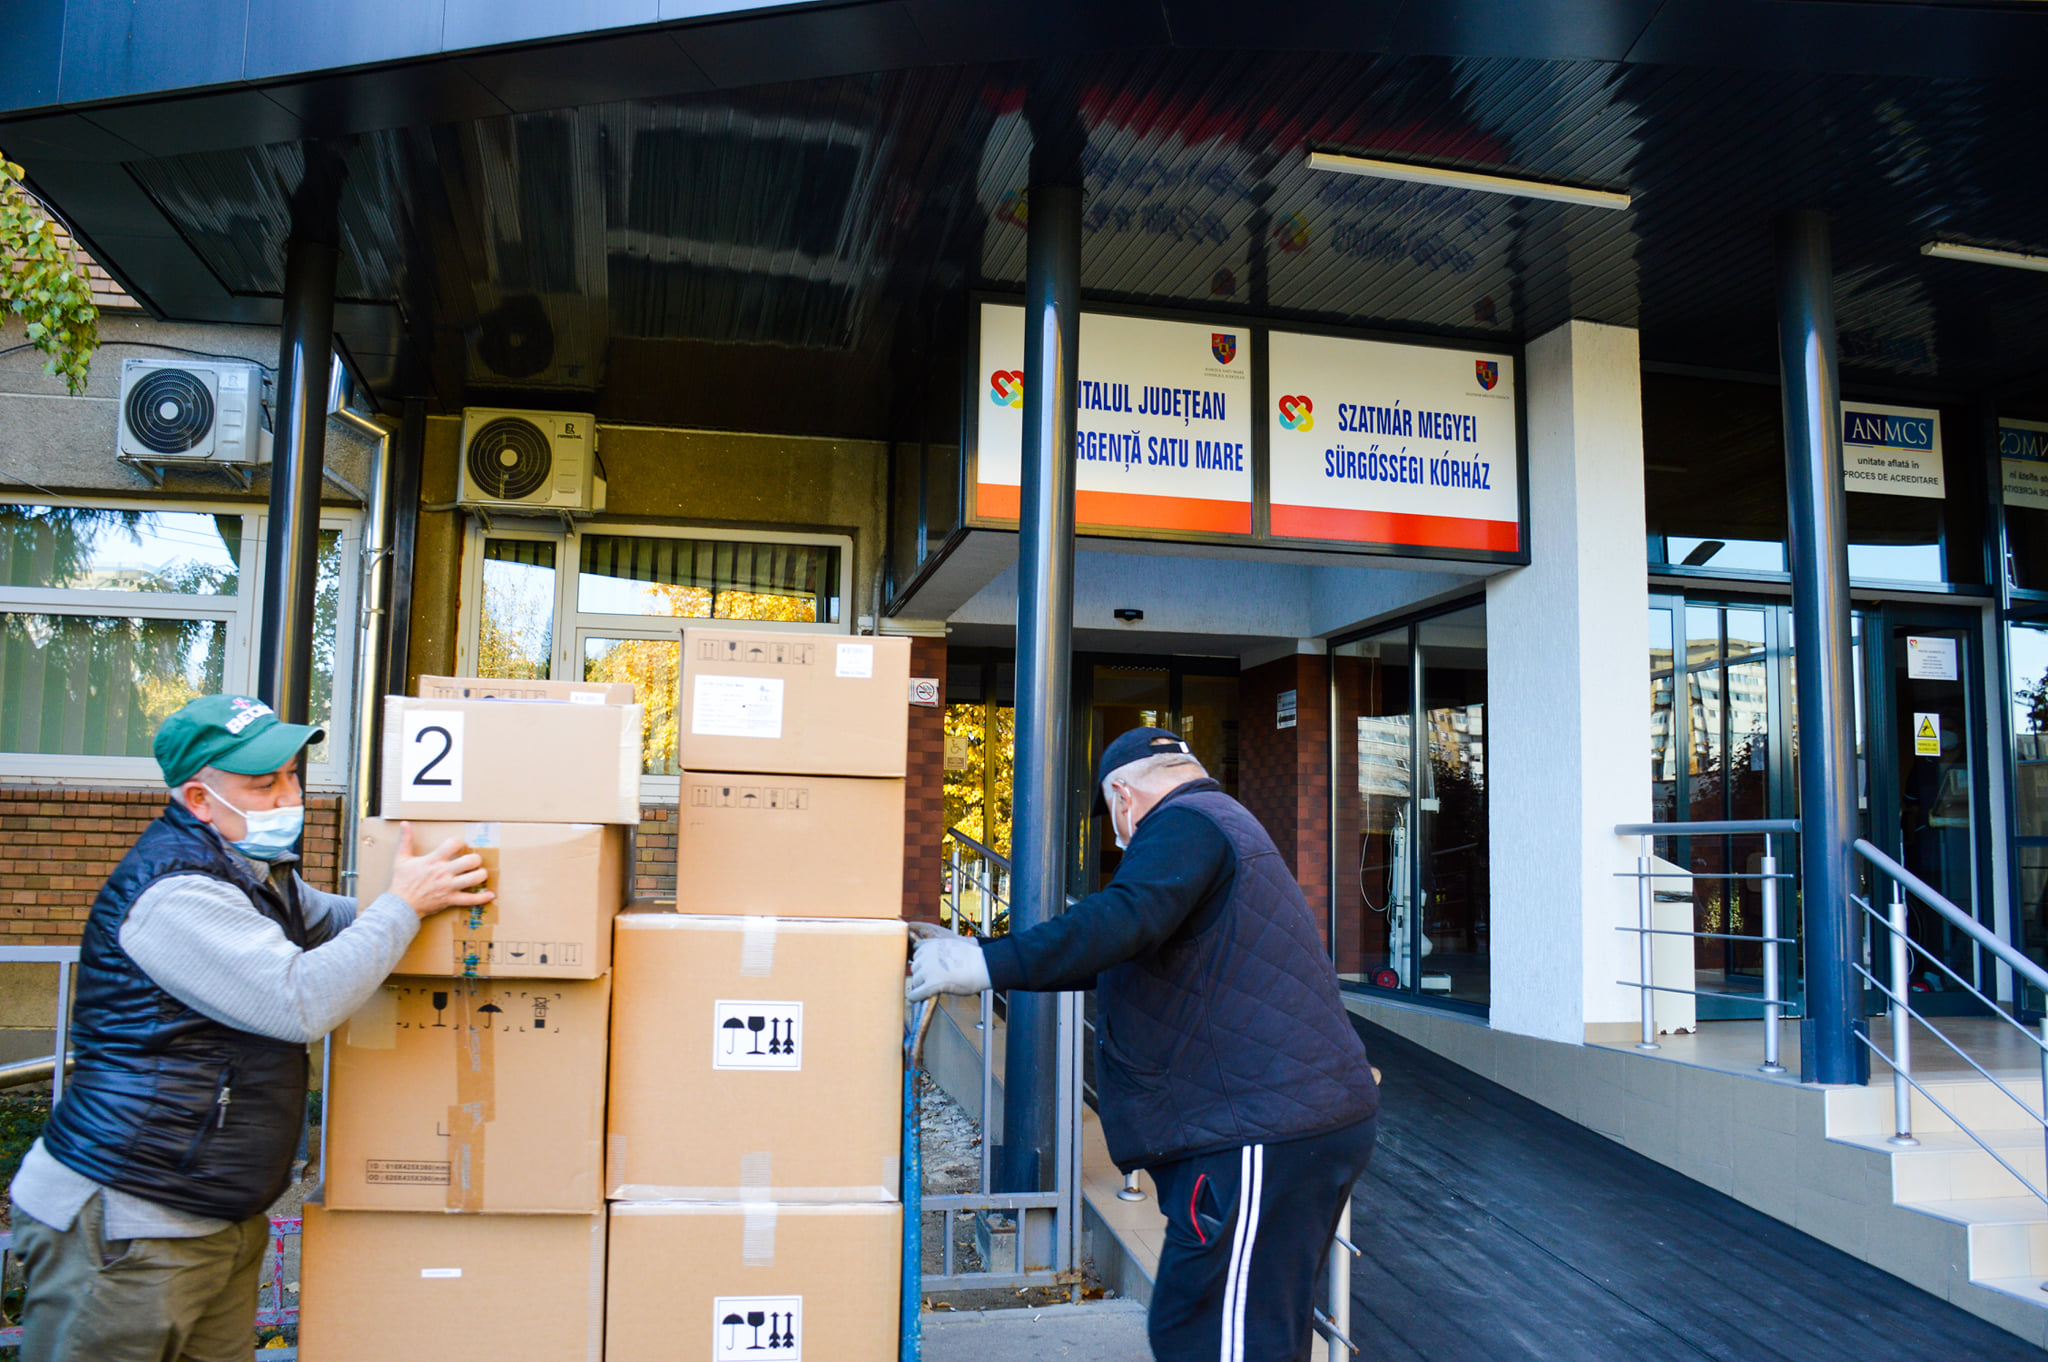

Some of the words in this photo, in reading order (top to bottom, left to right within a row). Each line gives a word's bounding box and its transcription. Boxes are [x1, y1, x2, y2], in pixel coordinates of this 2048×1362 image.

[1077, 380, 1132, 413] ITALUL
[1138, 385, 1226, 427] JUDEȚEAN
[1338, 399, 1413, 437] SZATMÁR
[1418, 411, 1477, 443] MEGYEI
[1076, 429, 1142, 473] RGENȚĂ
[1148, 436, 1189, 468] SATU
[1196, 440, 1244, 472] MARE
[1852, 417, 1928, 445] ANMCS
[1325, 444, 1424, 485] SÜRGŐSSÉGI
[1430, 450, 1491, 490] KÓRHÁZ
[1843, 470, 1876, 481] PROCES
[1877, 473, 1889, 481] DE
[1890, 474, 1939, 485] ACREDITARE
[1857, 457, 1886, 467] unitate
[412, 725, 453, 786] 2
